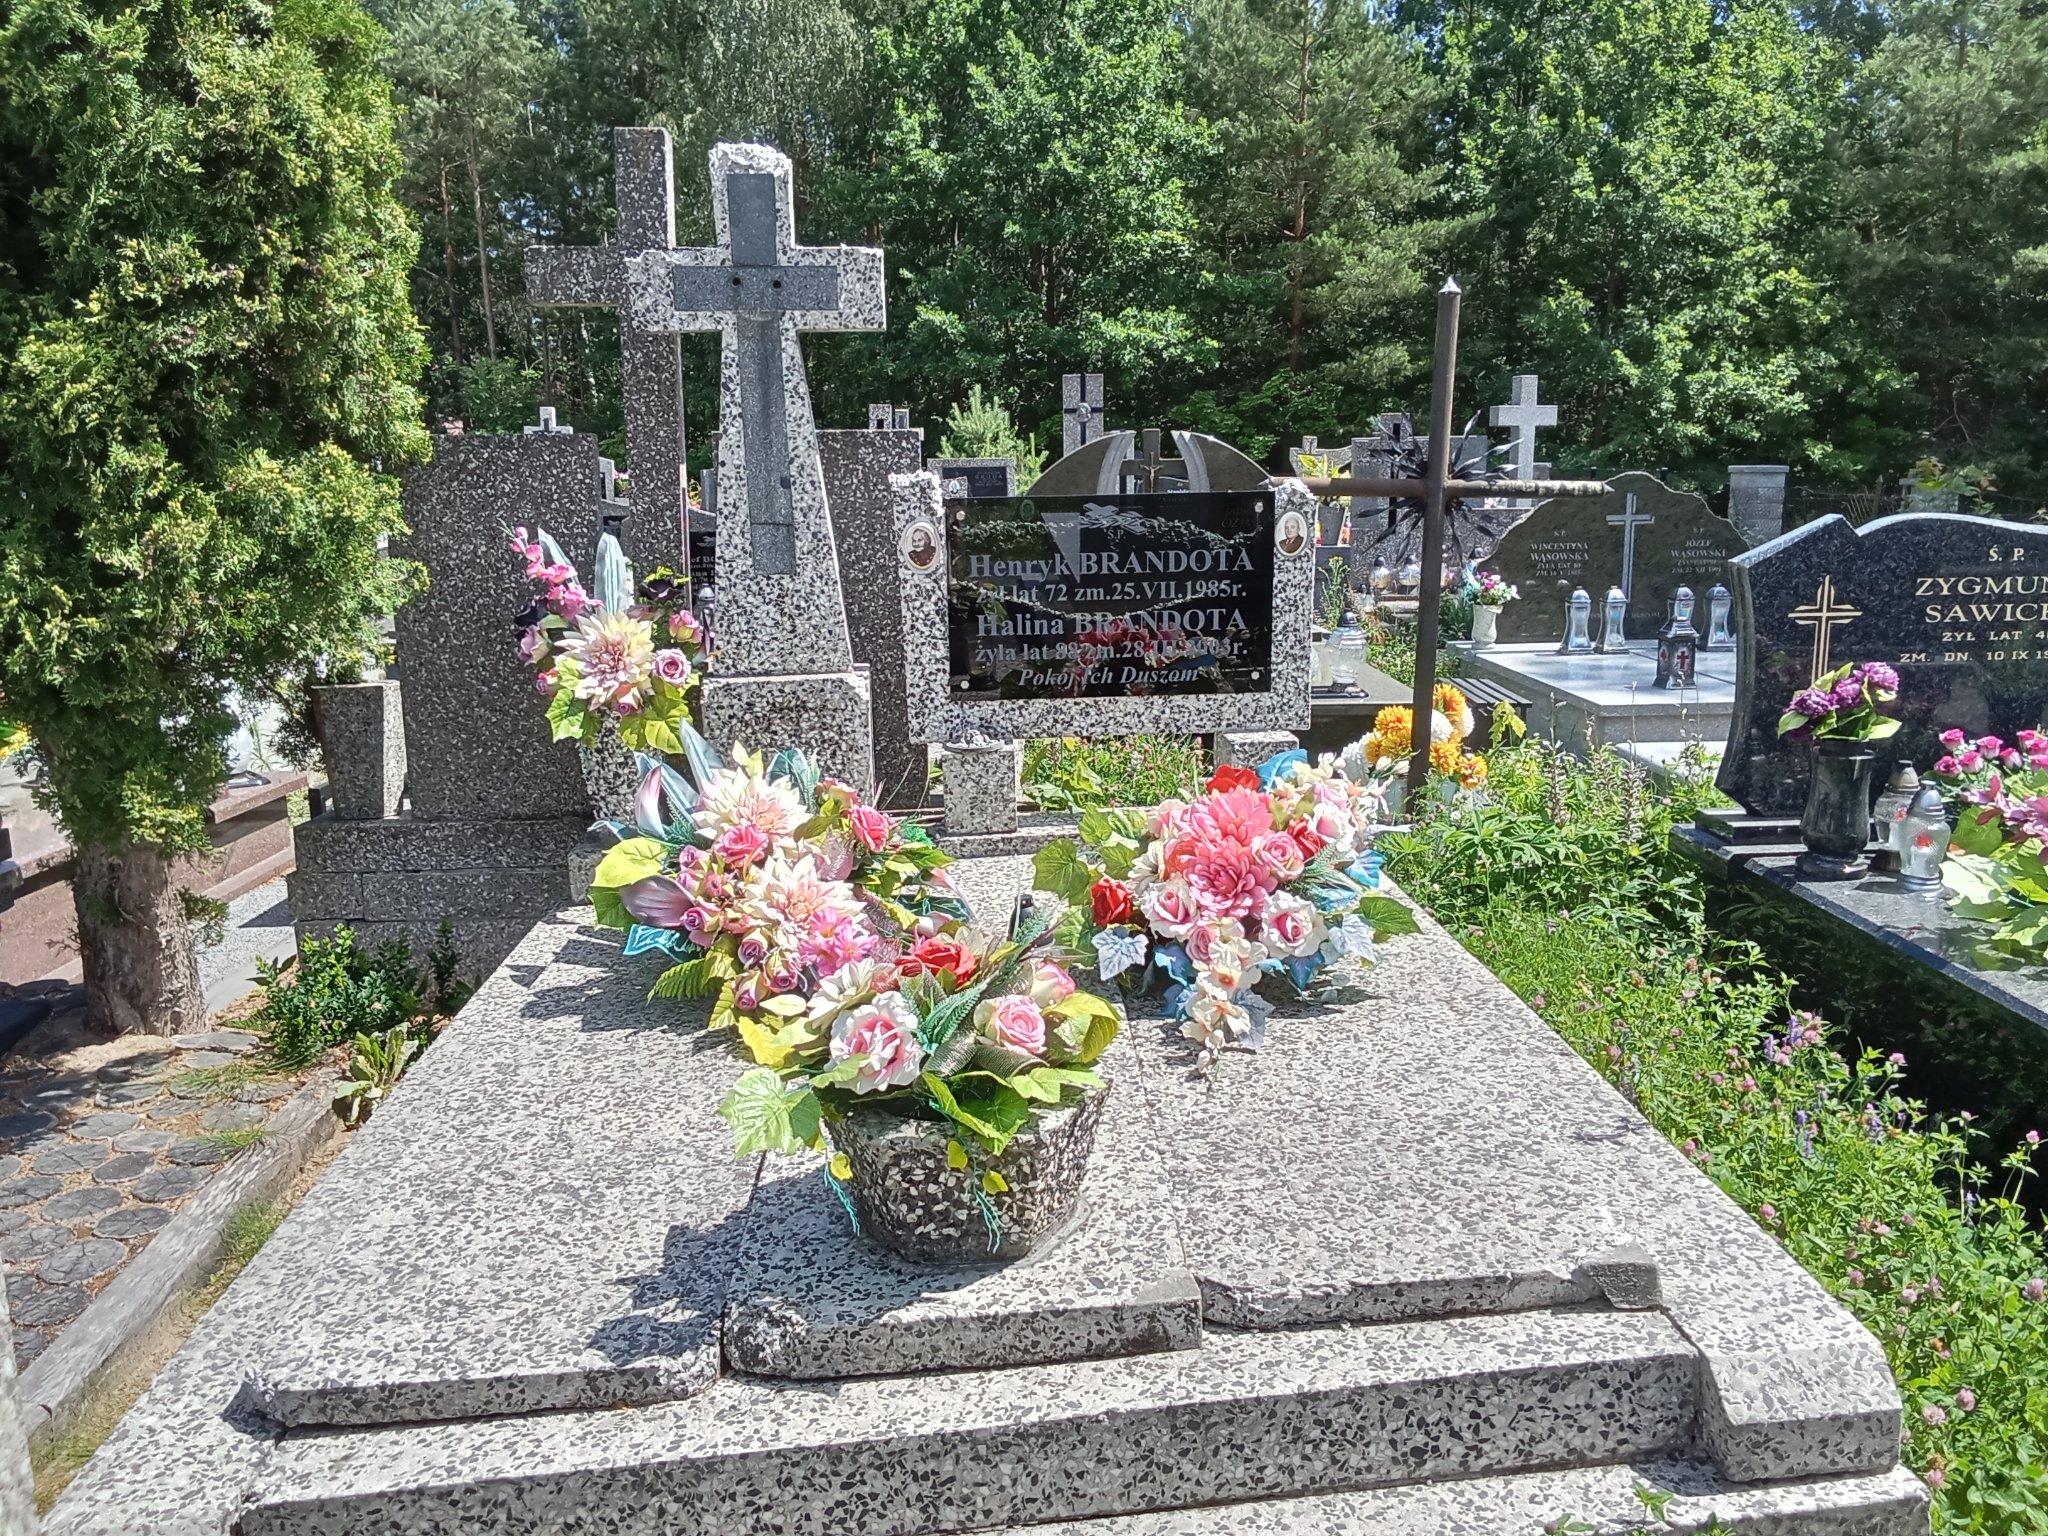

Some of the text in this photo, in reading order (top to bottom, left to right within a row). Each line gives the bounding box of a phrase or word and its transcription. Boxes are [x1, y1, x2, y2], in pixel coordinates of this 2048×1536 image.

[1530, 552, 1589, 562] WĄSOWSKA
[1671, 549, 1726, 559] WĄSOWSKI
[969, 547, 1255, 582] Henryk BRANDOTA
[1012, 584, 1039, 602] lat
[1045, 584, 1068, 602] 72
[975, 608, 1248, 636] Halina BRANDOTA
[1989, 630, 2023, 641] LAT
[1022, 643, 1050, 660] lat
[1900, 652, 1931, 662] ZM.
[1944, 651, 1973, 662] DN.
[1986, 650, 2004, 660] 10
[2011, 650, 2030, 660] IX
